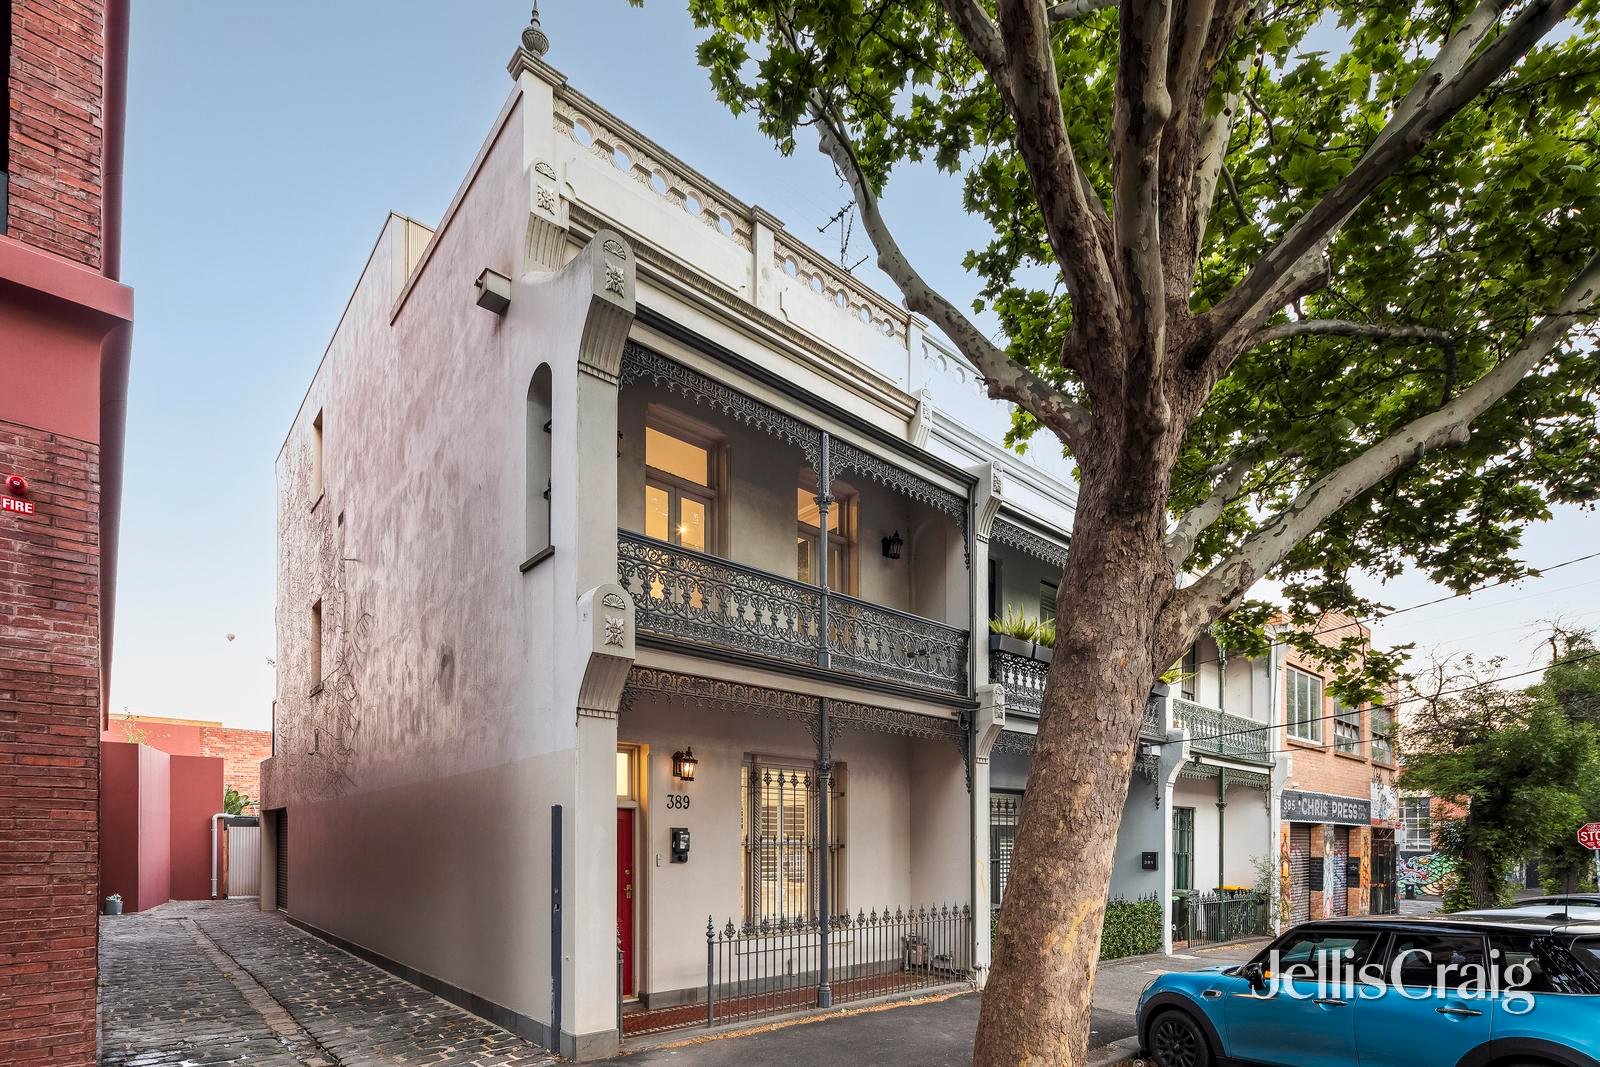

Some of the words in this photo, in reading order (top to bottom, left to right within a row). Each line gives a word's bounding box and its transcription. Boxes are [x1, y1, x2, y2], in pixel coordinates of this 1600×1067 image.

[2, 498, 33, 513] FIRE
[666, 794, 690, 809] 389
[1283, 799, 1296, 811] 395
[1301, 798, 1328, 817] CHRIS
[1331, 801, 1358, 820] PRESS
